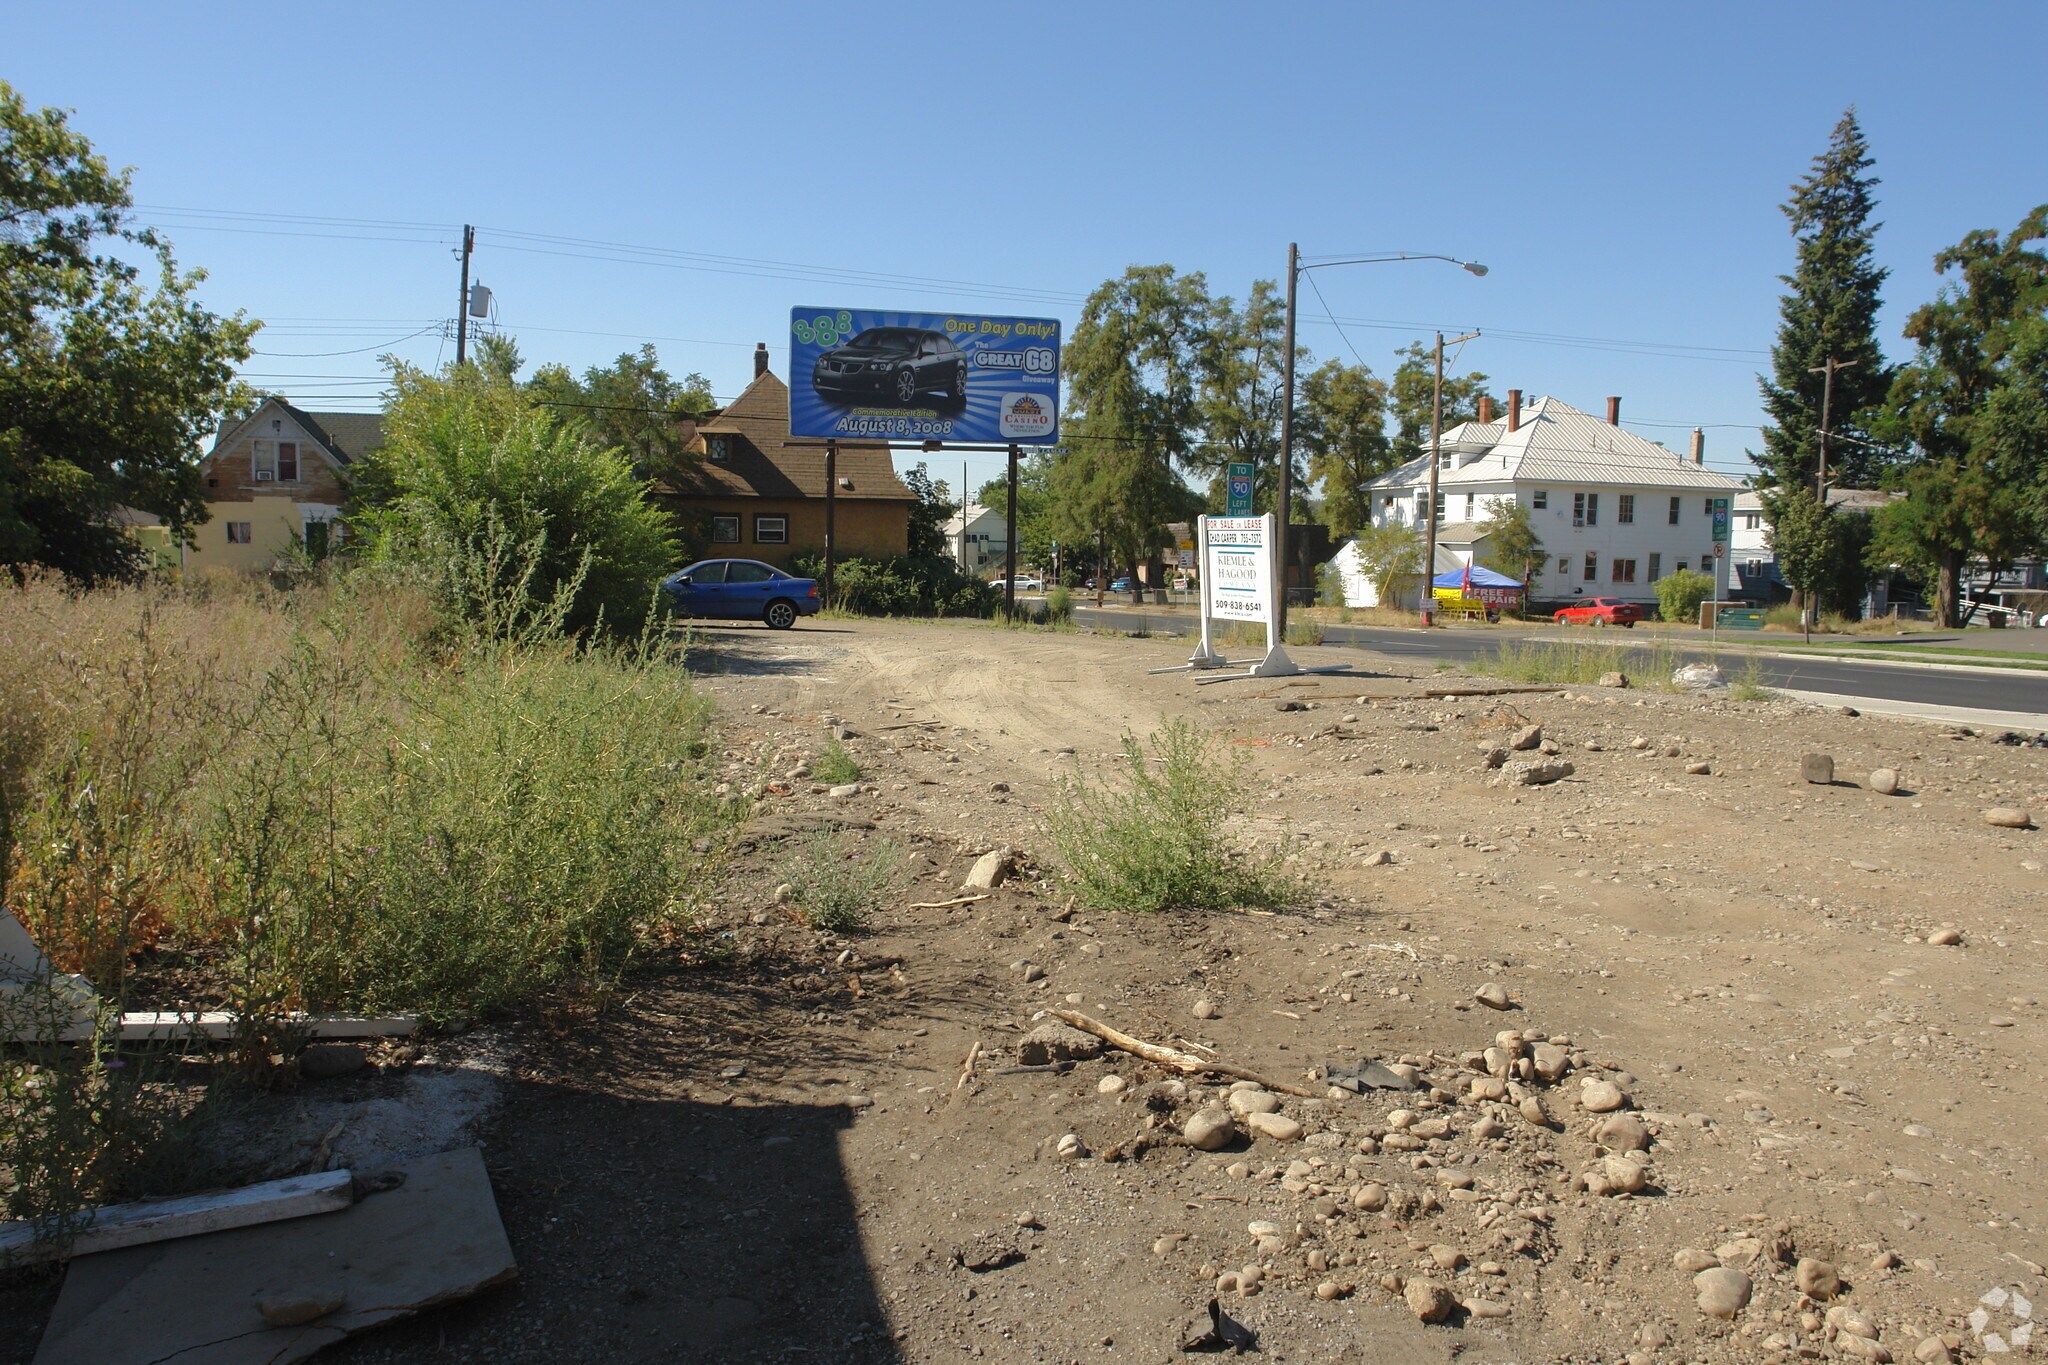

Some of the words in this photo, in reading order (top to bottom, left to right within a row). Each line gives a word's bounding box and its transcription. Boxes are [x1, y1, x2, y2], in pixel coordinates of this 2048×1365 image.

[945, 319, 976, 333] One
[980, 321, 1011, 338] Day
[1015, 322, 1057, 340] Only!
[975, 341, 989, 349] The
[976, 352, 1022, 367] GREAT
[1024, 348, 1055, 372] G8
[1022, 375, 1055, 385] Giveaway
[852, 408, 912, 417] Commemorative
[912, 409, 937, 418] Edition
[1005, 414, 1048, 425] CASINO
[837, 417, 893, 436] August
[896, 419, 910, 436] 8,
[912, 420, 952, 434] 2008
[1236, 466, 1247, 475] TO
[1234, 482, 1248, 494] 90
[1232, 500, 1247, 508] LEFT
[1715, 512, 1725, 521] 90
[1207, 520, 1217, 529] FOR
[1220, 520, 1234, 529] SALE
[1244, 519, 1262, 529] LEASE
[1221, 533, 1237, 543] CARPER
[1218, 555, 1247, 567] KIEMLE
[1247, 556, 1256, 567] &
[1218, 568, 1257, 580] HAGOOD
[1473, 588, 1504, 596] FREE
[1438, 601, 1444, 610] 5
